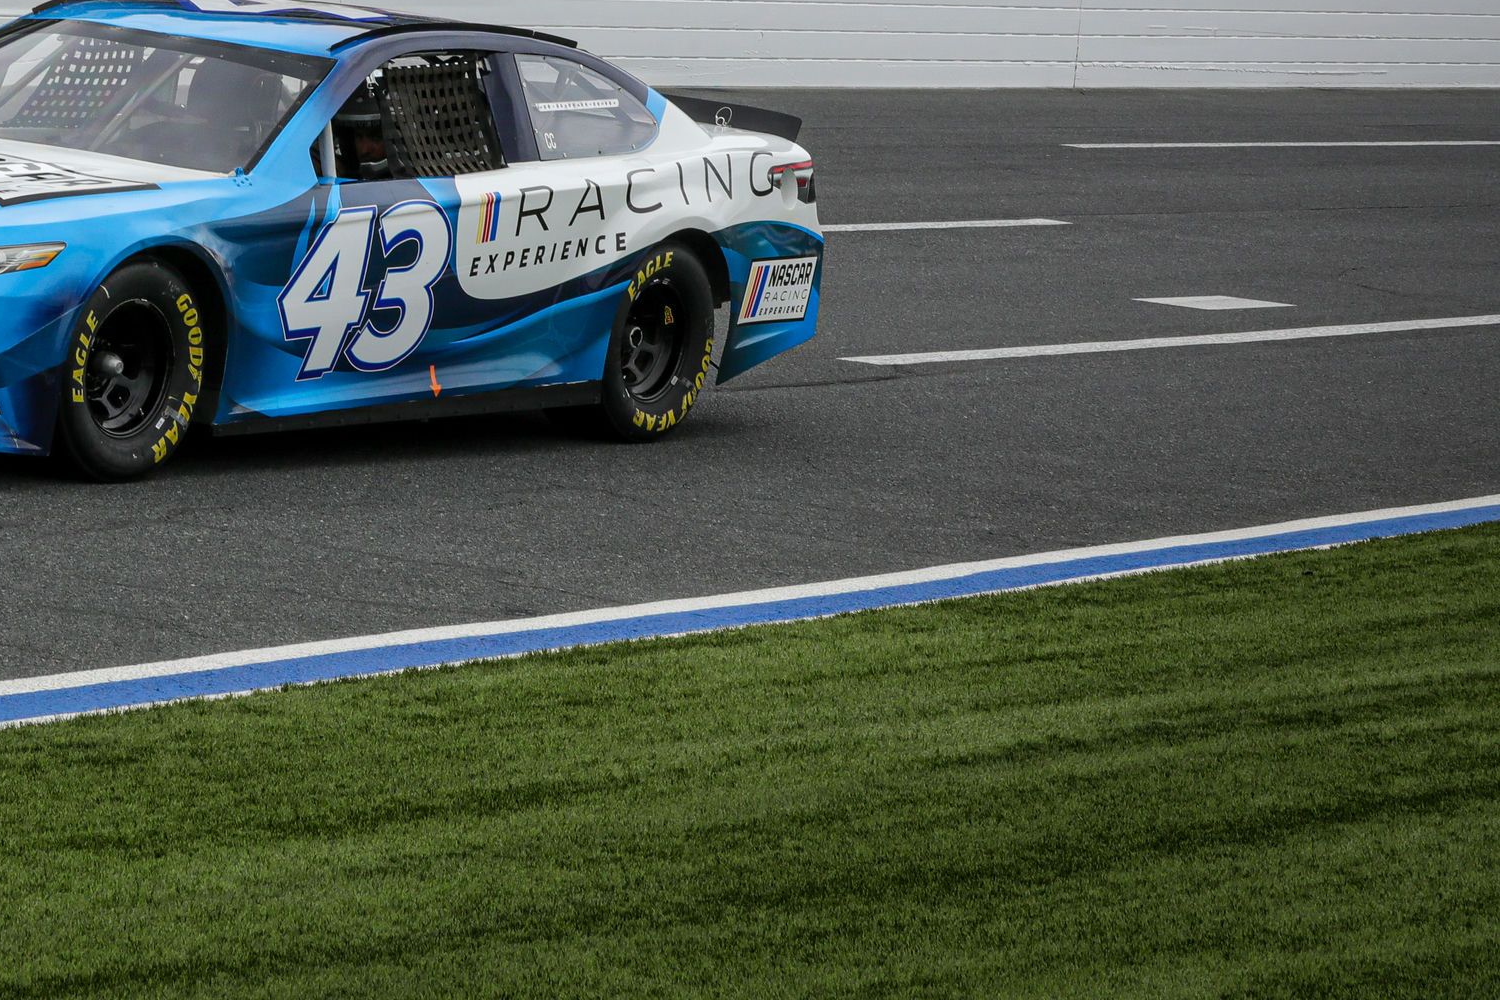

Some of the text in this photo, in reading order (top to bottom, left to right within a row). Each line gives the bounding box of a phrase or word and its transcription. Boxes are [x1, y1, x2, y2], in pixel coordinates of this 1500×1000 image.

[544, 132, 557, 149] CC
[515, 152, 775, 237] RACING
[469, 232, 627, 278] EXPERIENCE
[627, 251, 674, 302] EAGLE
[768, 262, 813, 287] NASCAR
[276, 199, 453, 382] 43
[758, 304, 805, 316] EXPERIENCE
[763, 288, 808, 302] RACING
[72, 310, 99, 403] EAGLE
